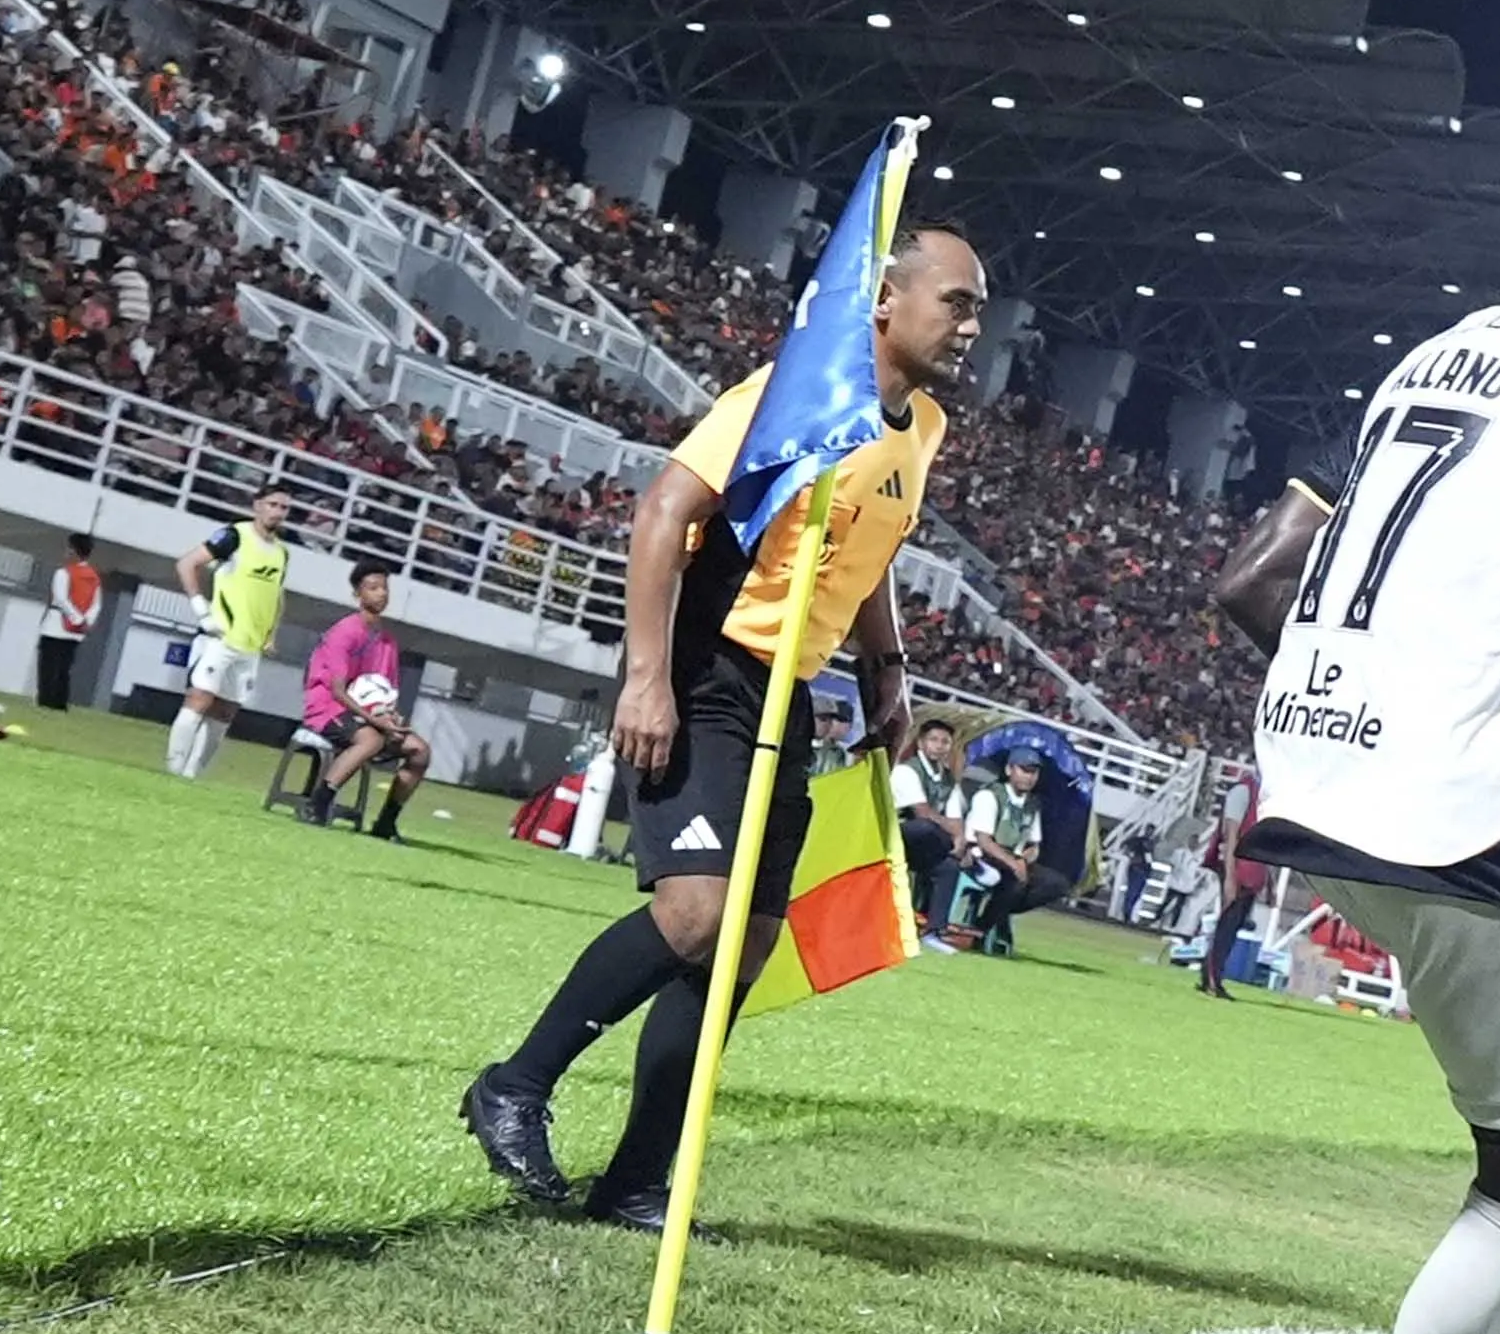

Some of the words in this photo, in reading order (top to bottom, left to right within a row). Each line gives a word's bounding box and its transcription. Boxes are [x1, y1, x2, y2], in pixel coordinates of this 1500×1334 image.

[1294, 403, 1492, 631] 17
[1306, 649, 1343, 697] Le
[1259, 691, 1383, 750] Minerale
